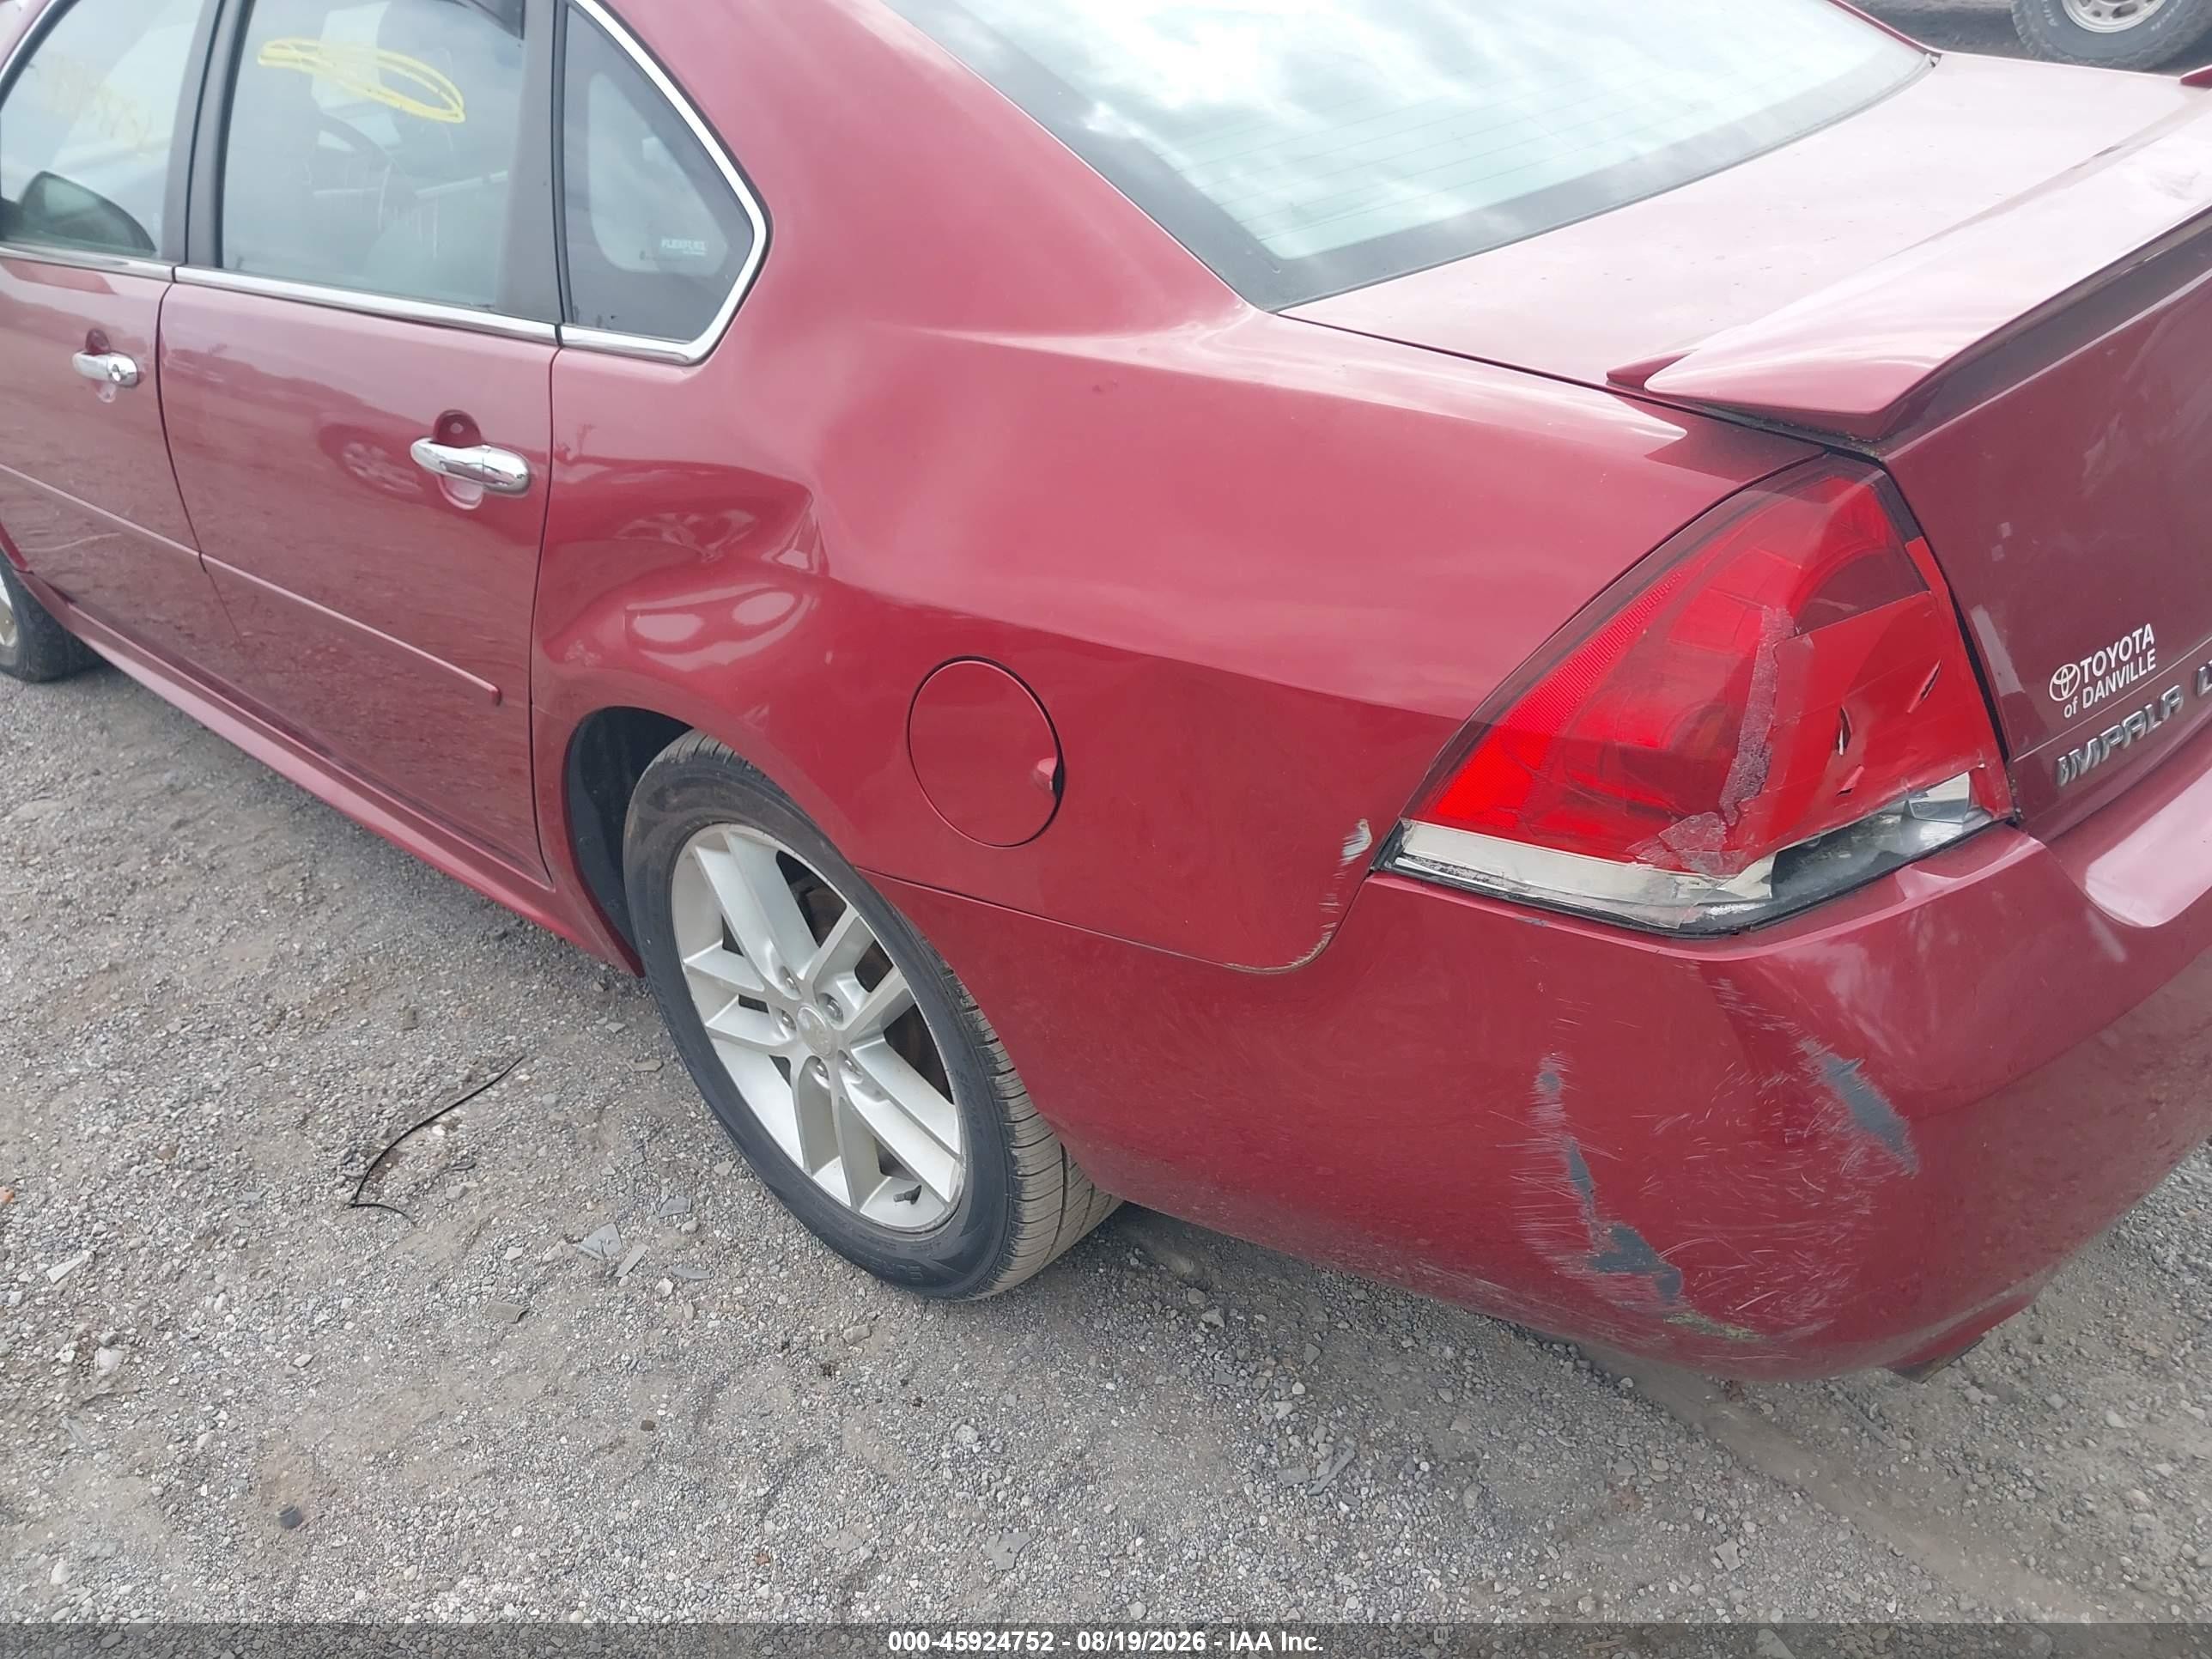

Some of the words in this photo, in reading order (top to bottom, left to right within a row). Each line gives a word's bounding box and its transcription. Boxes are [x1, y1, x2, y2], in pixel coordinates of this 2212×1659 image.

[2063, 696, 2078, 718] of
[2082, 647, 2156, 709] DANVILLE
[2080, 623, 2155, 684] TOYOTA
[2057, 684, 2184, 787] IMPALA
